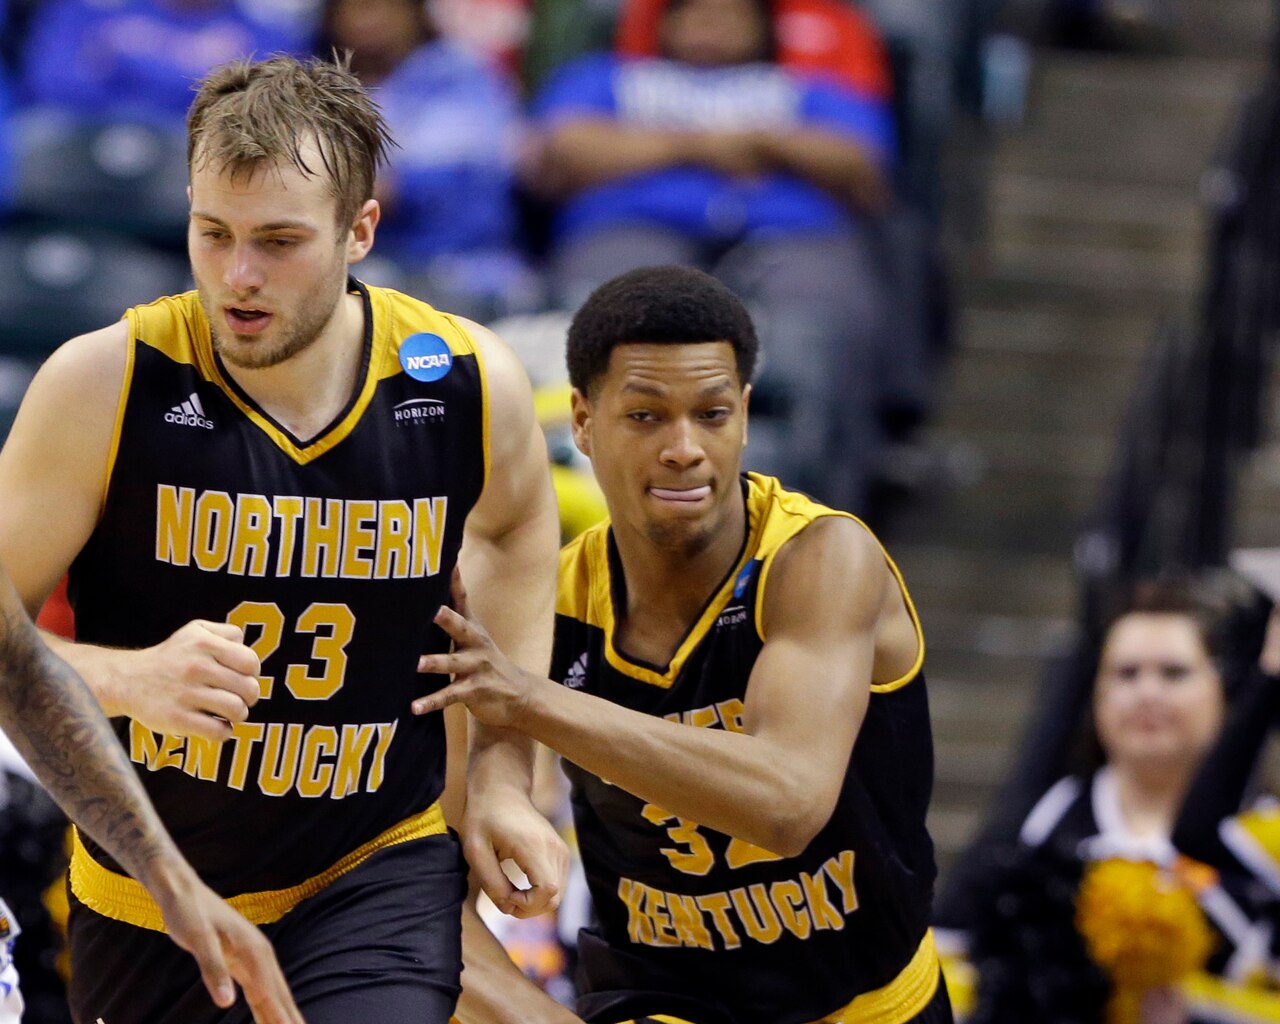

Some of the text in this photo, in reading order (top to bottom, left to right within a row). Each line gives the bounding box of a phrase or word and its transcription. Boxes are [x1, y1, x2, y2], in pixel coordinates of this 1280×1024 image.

[406, 354, 450, 370] NCAA
[163, 412, 214, 430] adidas
[394, 405, 445, 422] HORIZON
[155, 483, 448, 580] NORTHERN
[226, 600, 357, 701] 23
[618, 849, 860, 951] KENTUCKY
